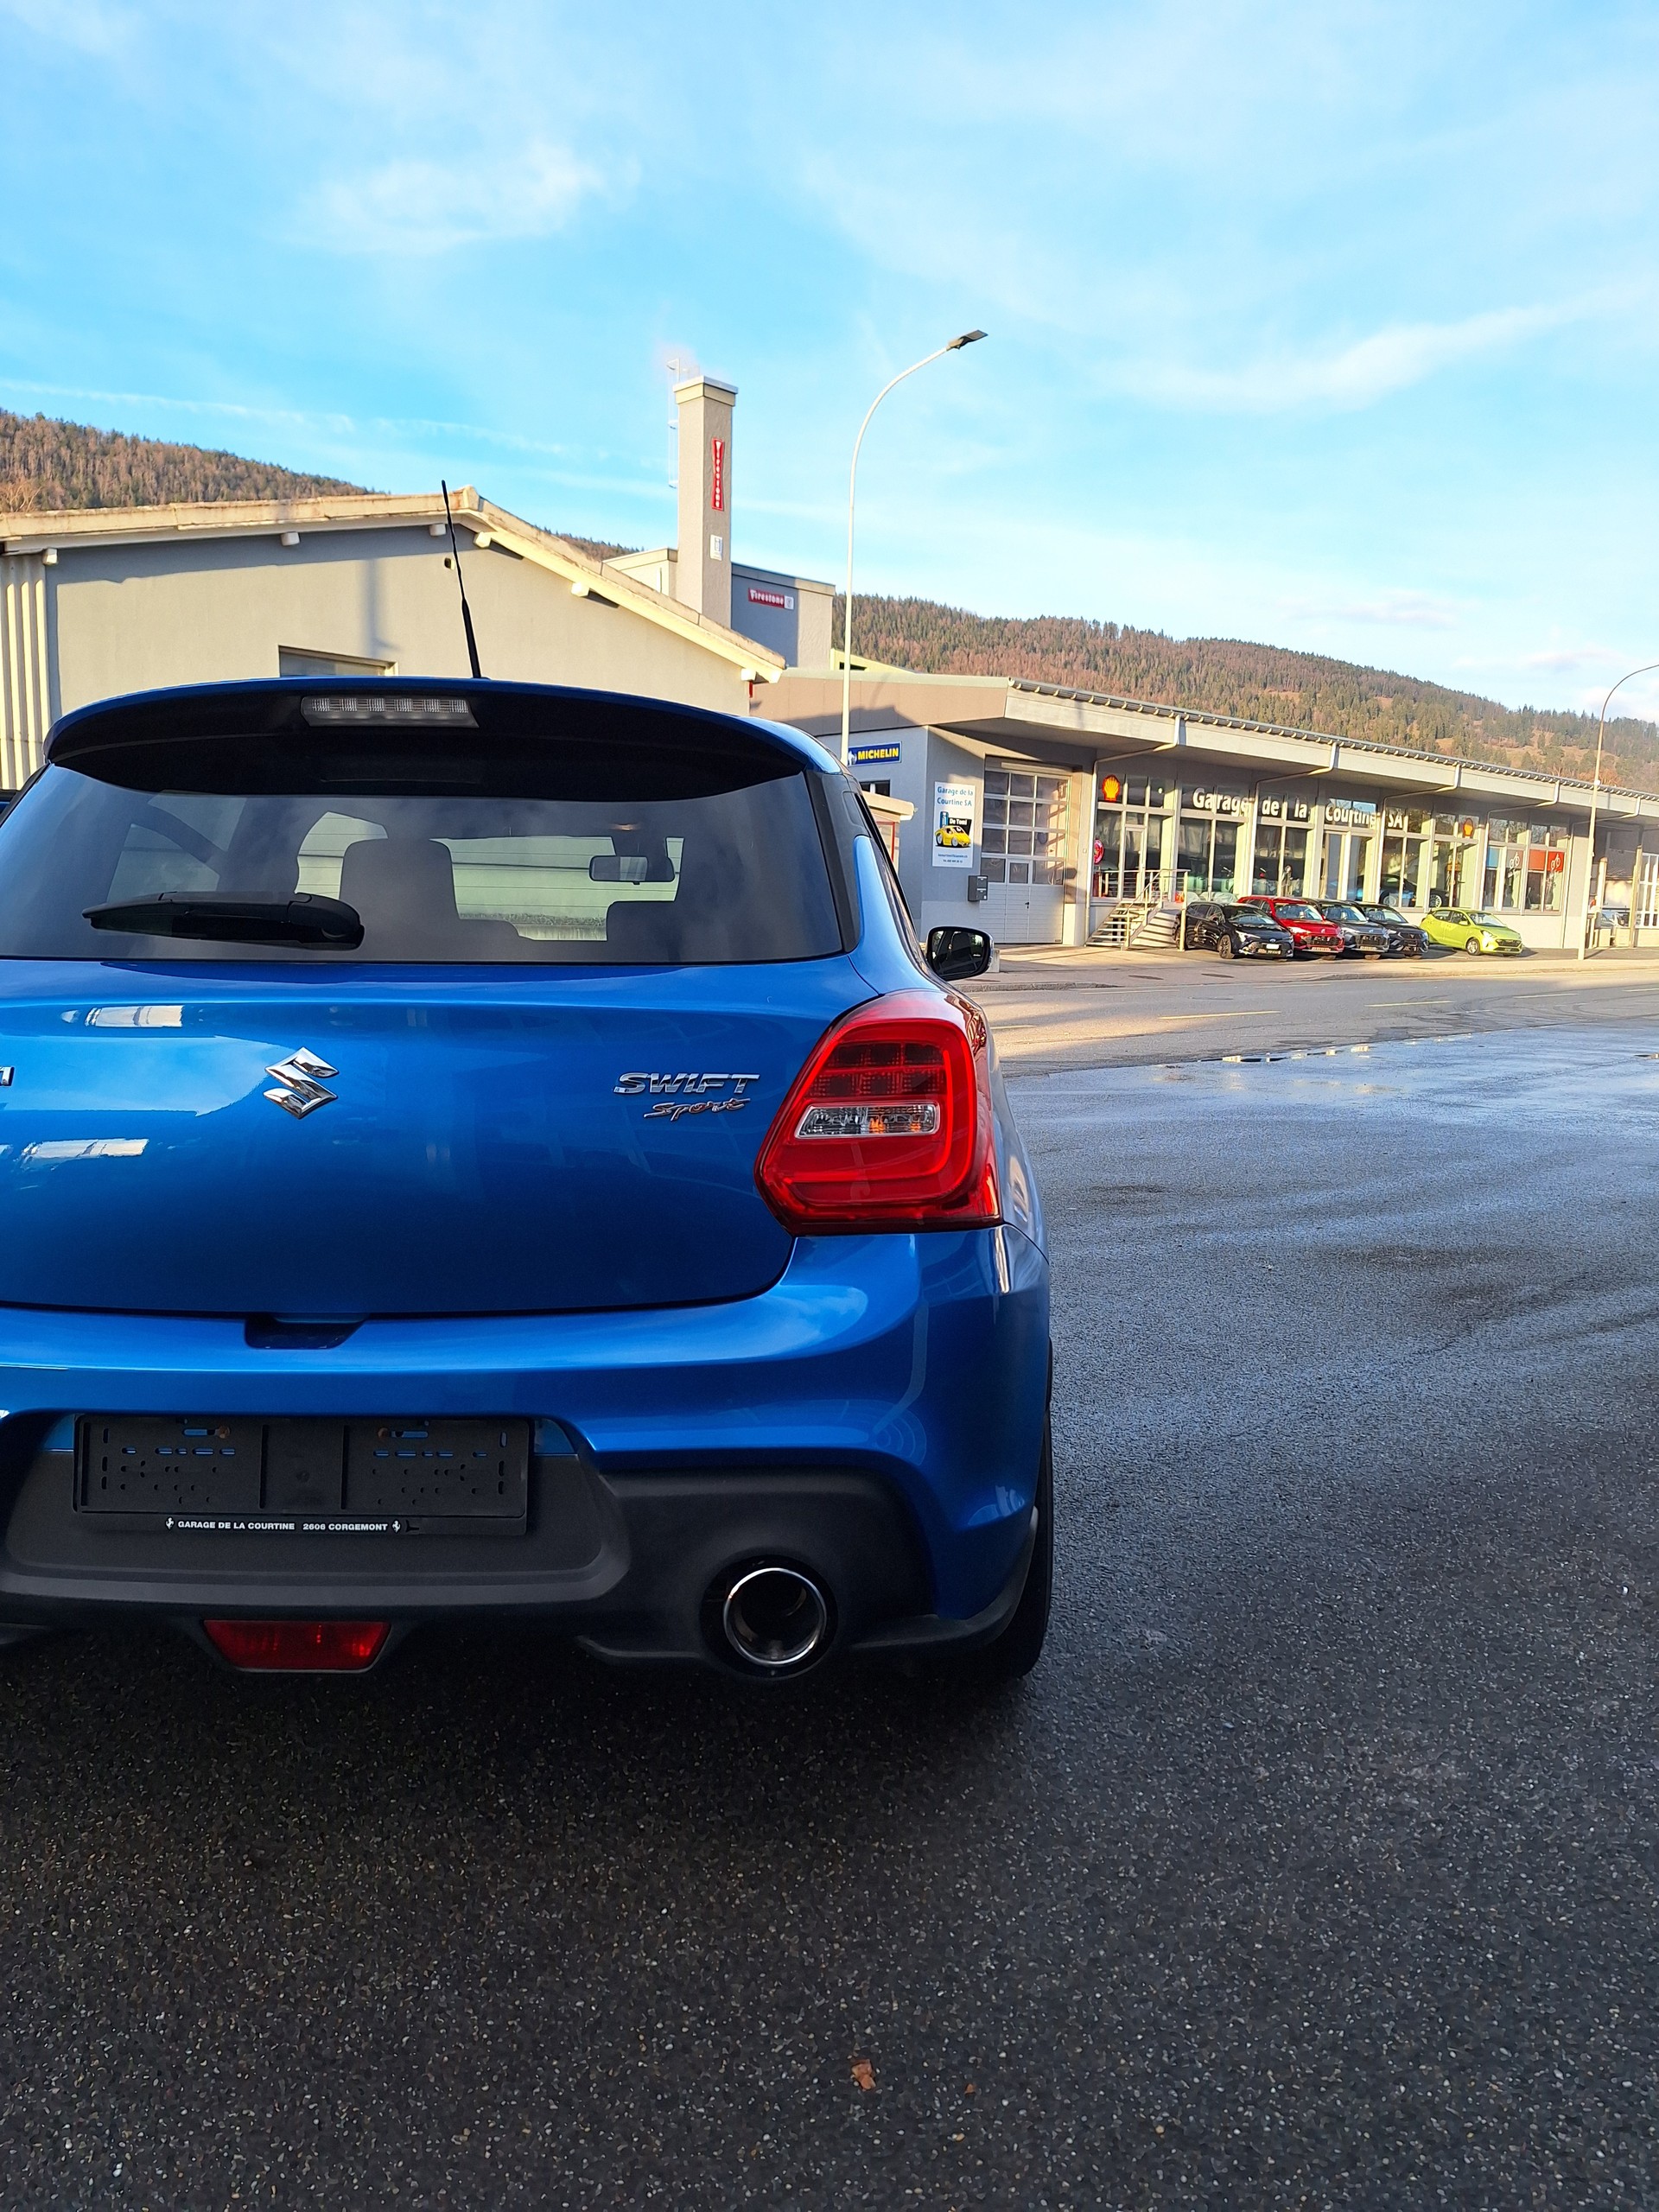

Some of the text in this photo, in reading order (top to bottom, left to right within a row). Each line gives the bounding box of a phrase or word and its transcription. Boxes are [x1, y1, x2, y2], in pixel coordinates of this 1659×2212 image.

[750, 588, 785, 605] Firestone
[857, 747, 899, 760] MICHELIN
[937, 785, 958, 796] Garage
[937, 797, 963, 806] Courtine
[1192, 787, 1250, 817] Garage
[1262, 796, 1280, 816] de
[1294, 797, 1307, 818] la
[1388, 809, 1403, 829] SA
[613, 1071, 760, 1095] SWIFT
[643, 1097, 751, 1122] Sport
[177, 1521, 216, 1529] GARAGE
